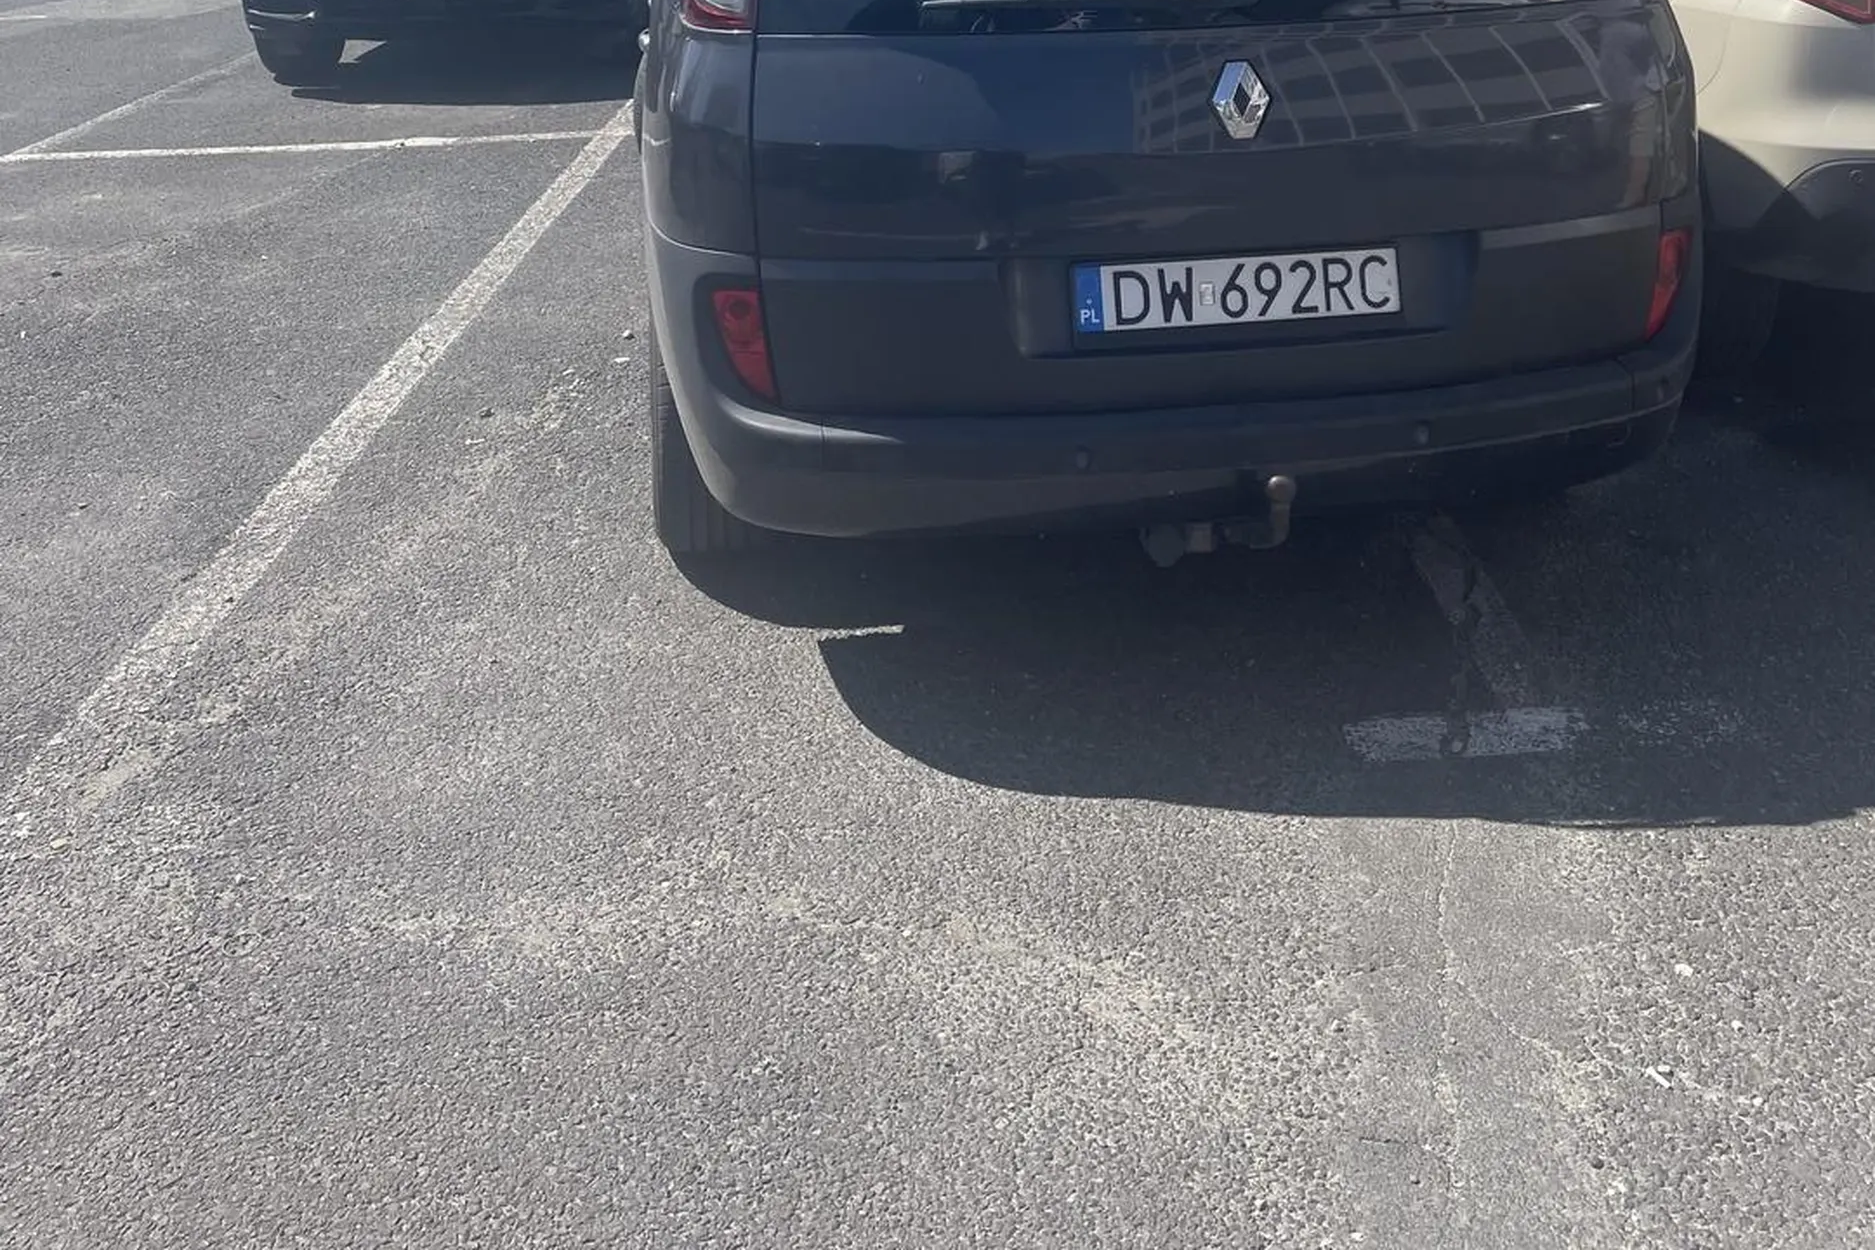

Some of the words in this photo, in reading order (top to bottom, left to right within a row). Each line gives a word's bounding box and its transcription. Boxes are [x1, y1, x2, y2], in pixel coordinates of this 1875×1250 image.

[1112, 266, 1194, 326] DW
[1220, 254, 1391, 320] 692RC
[1080, 308, 1100, 325] PL
